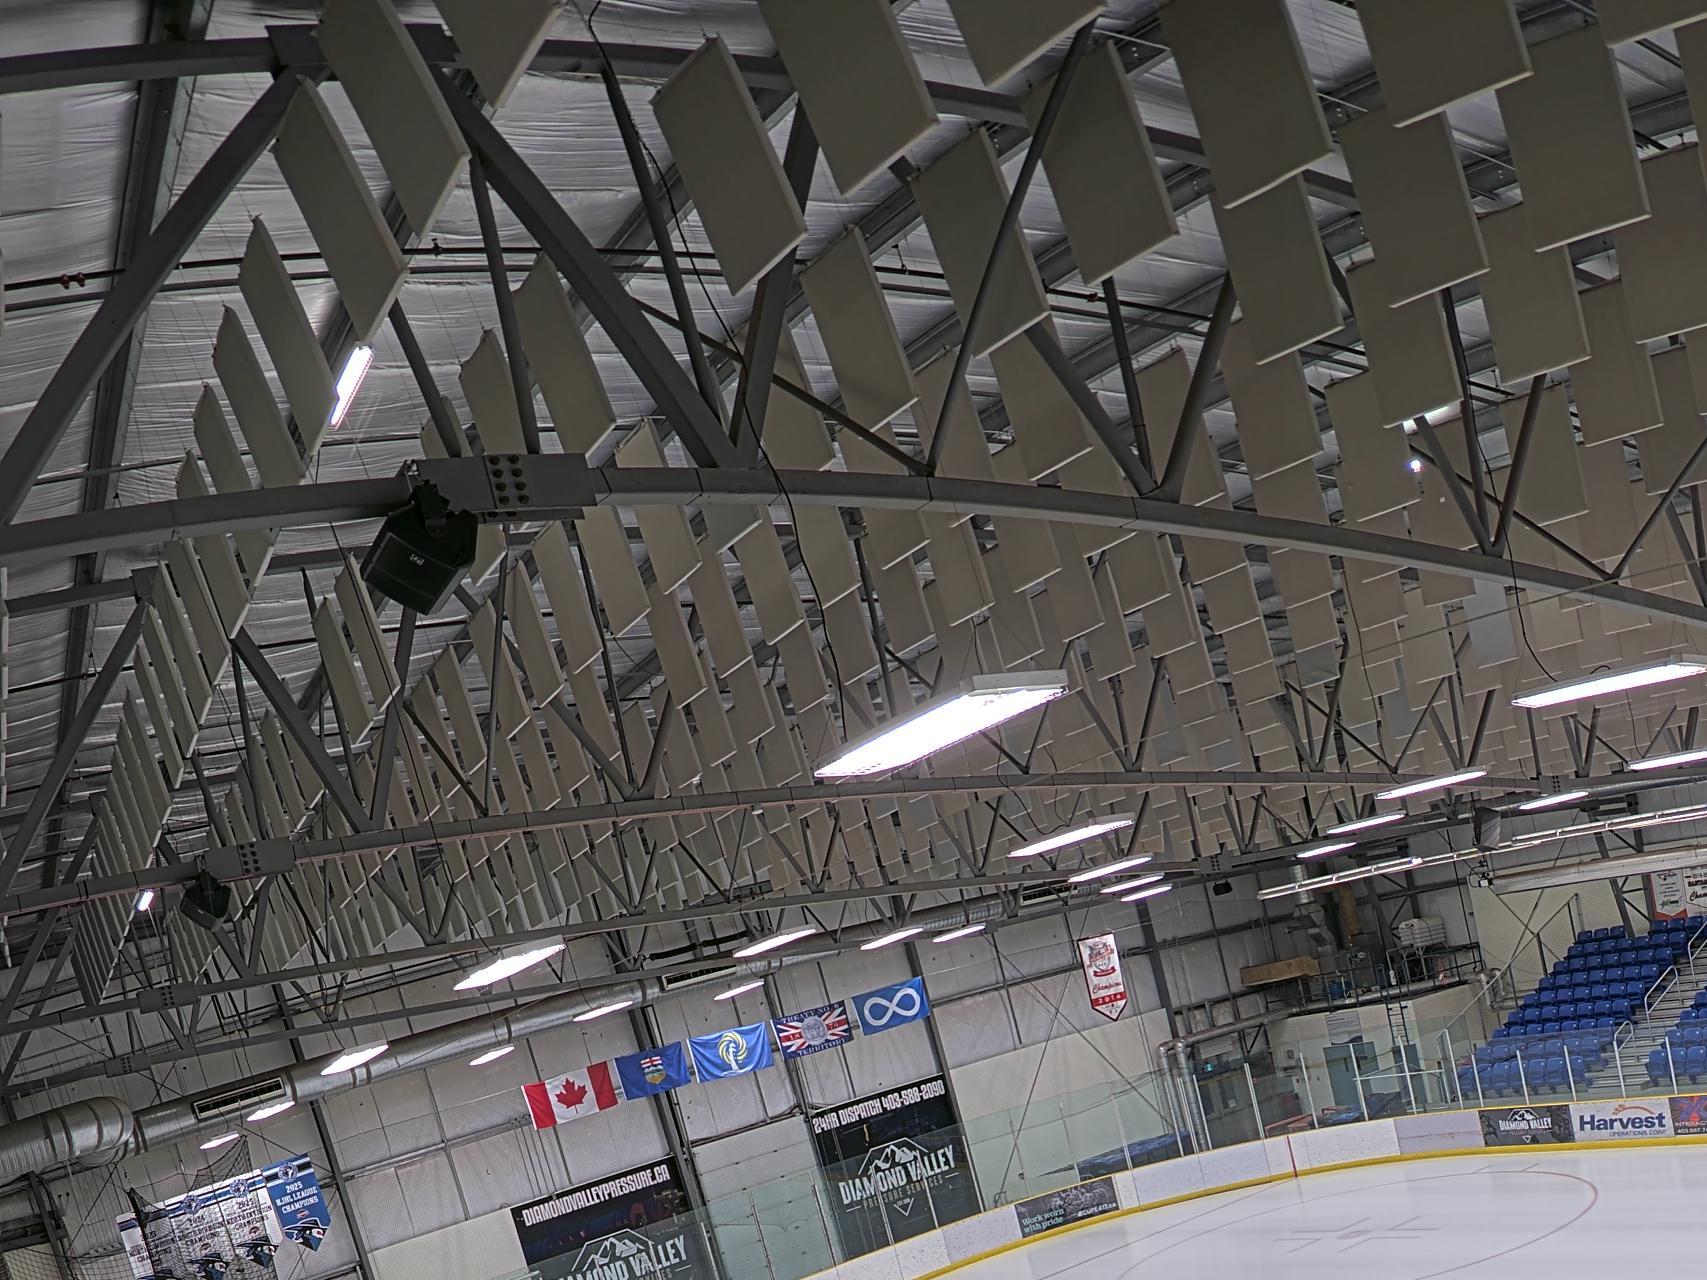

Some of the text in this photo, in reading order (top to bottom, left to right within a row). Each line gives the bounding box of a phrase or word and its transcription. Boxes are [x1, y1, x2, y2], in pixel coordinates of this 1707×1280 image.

[781, 1010, 815, 1024] TREATY
[798, 1038, 846, 1056] TERRITORY
[813, 1080, 945, 1134] 24HR DISPATCH 403-588-2090
[1498, 1117, 1552, 1131] DIAMOND VALLEY
[1579, 1112, 1666, 1131] Harvest
[839, 1145, 956, 1205] DIAMOND VALLEY
[285, 1181, 303, 1194] 2025
[293, 1186, 318, 1199] LEAGUE
[521, 1164, 671, 1228] DIAMONDVALLEYPRESSURE.CA
[281, 1196, 319, 1214] CHAMPIONS
[1022, 1213, 1043, 1226] Work
[1044, 1208, 1064, 1219] worn
[1023, 1216, 1064, 1233] with pride
[629, 1234, 687, 1277] VALLEY
